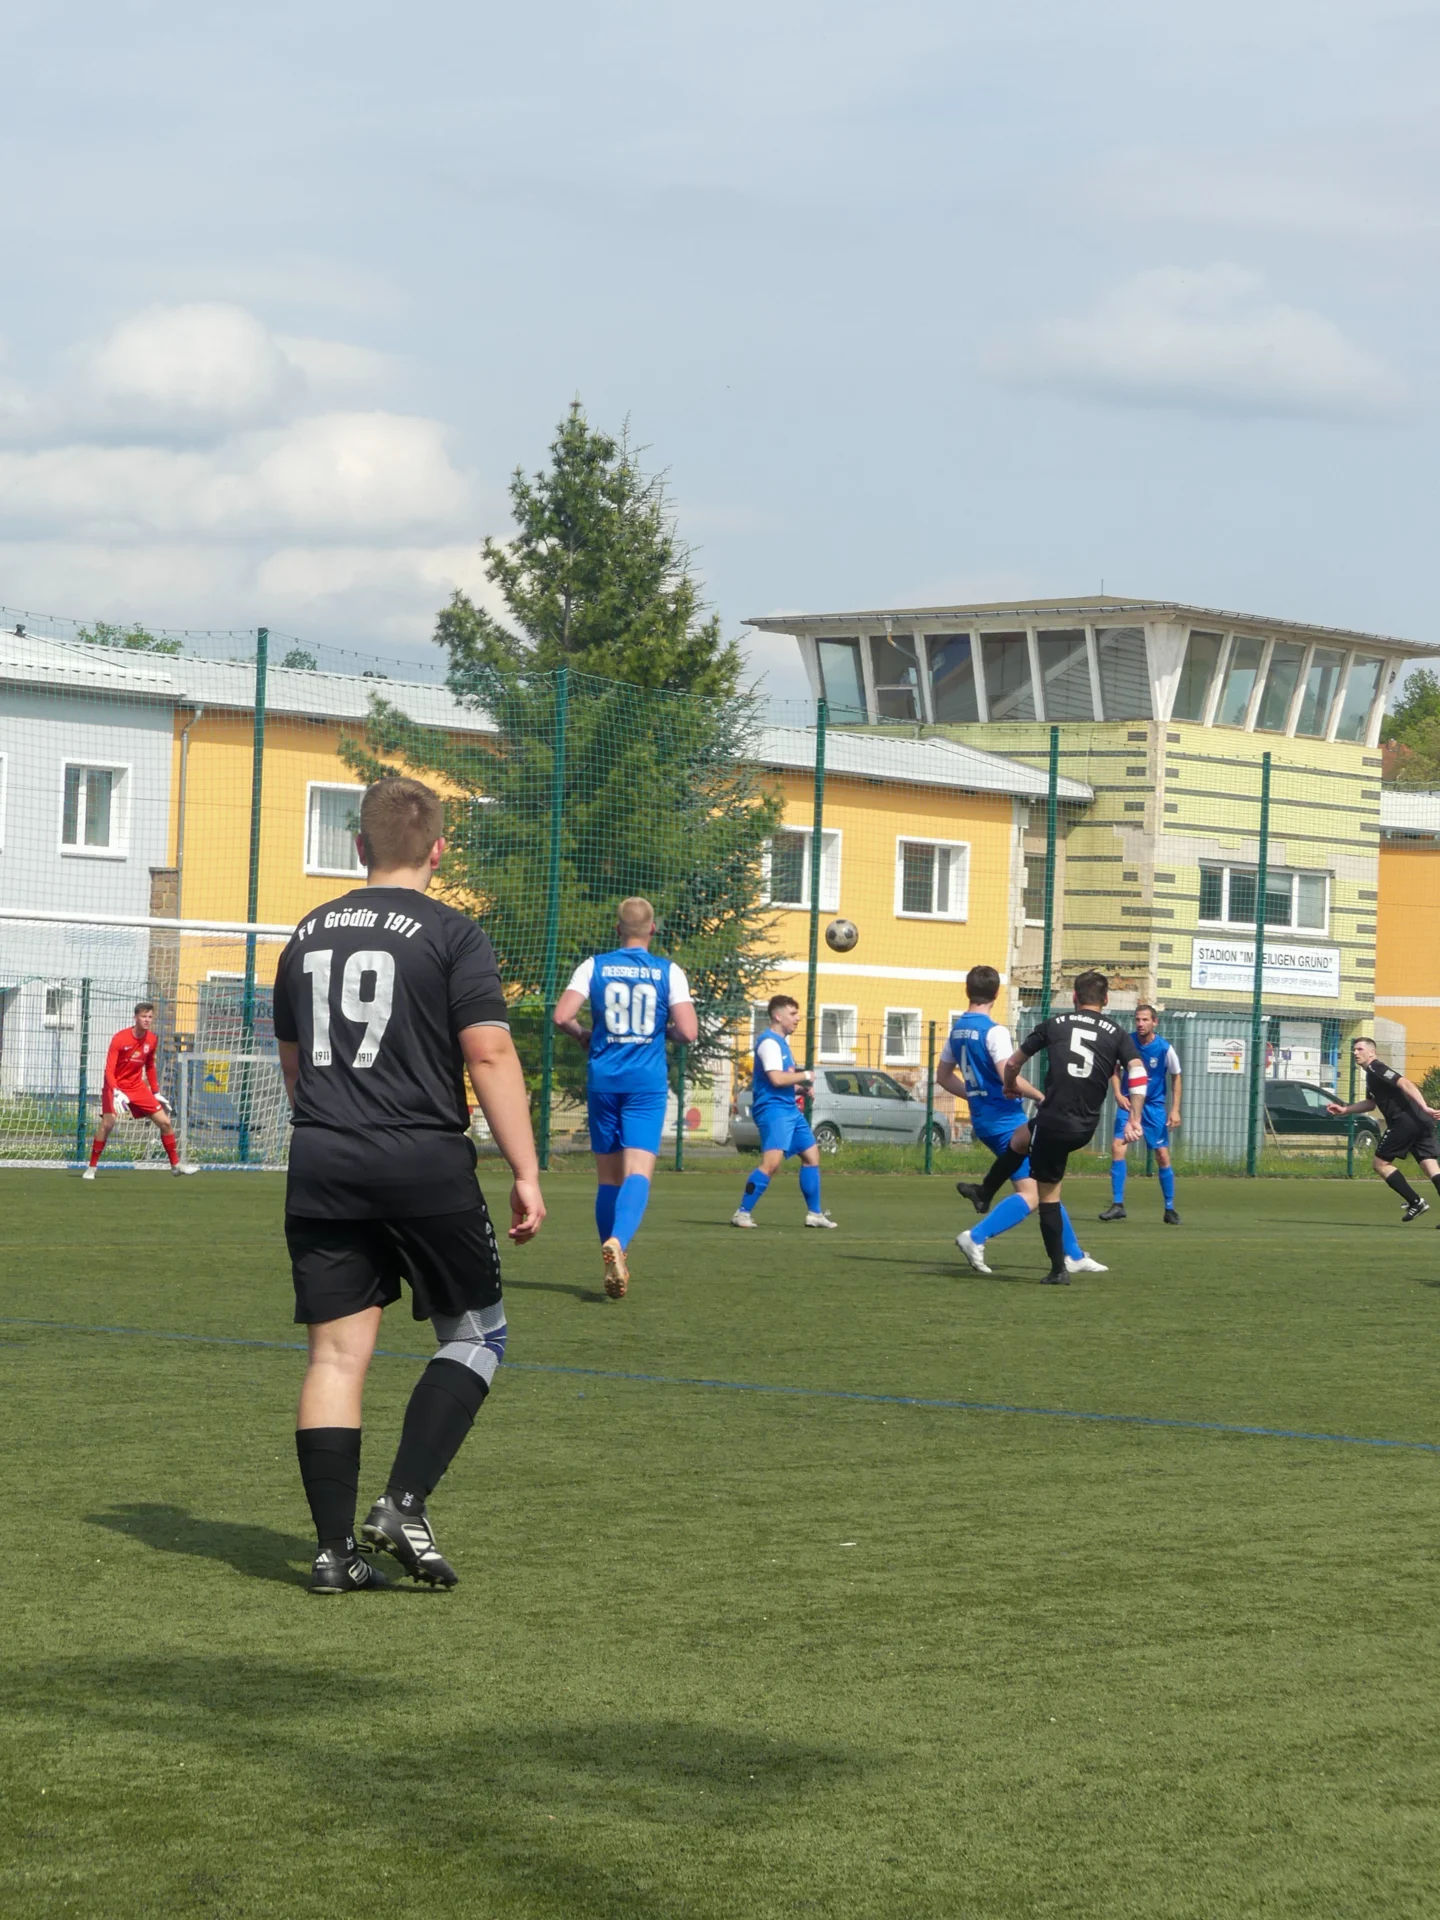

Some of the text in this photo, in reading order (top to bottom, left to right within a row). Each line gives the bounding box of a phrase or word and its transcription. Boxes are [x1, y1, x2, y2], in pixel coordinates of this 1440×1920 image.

[298, 908, 423, 941] FV Gröditz 1911
[1198, 948, 1237, 962] STADION
[1260, 953, 1296, 966] EILIGEN
[1298, 955, 1333, 969] GRUND"
[303, 949, 396, 1068] 19
[604, 982, 657, 1036] 80
[1055, 1015, 1066, 1024] FV
[1098, 1020, 1117, 1035] 1911
[315, 1051, 330, 1061] 1911
[358, 1053, 373, 1063] 1911
[961, 1044, 979, 1088] 4
[1067, 1027, 1098, 1078] 5
